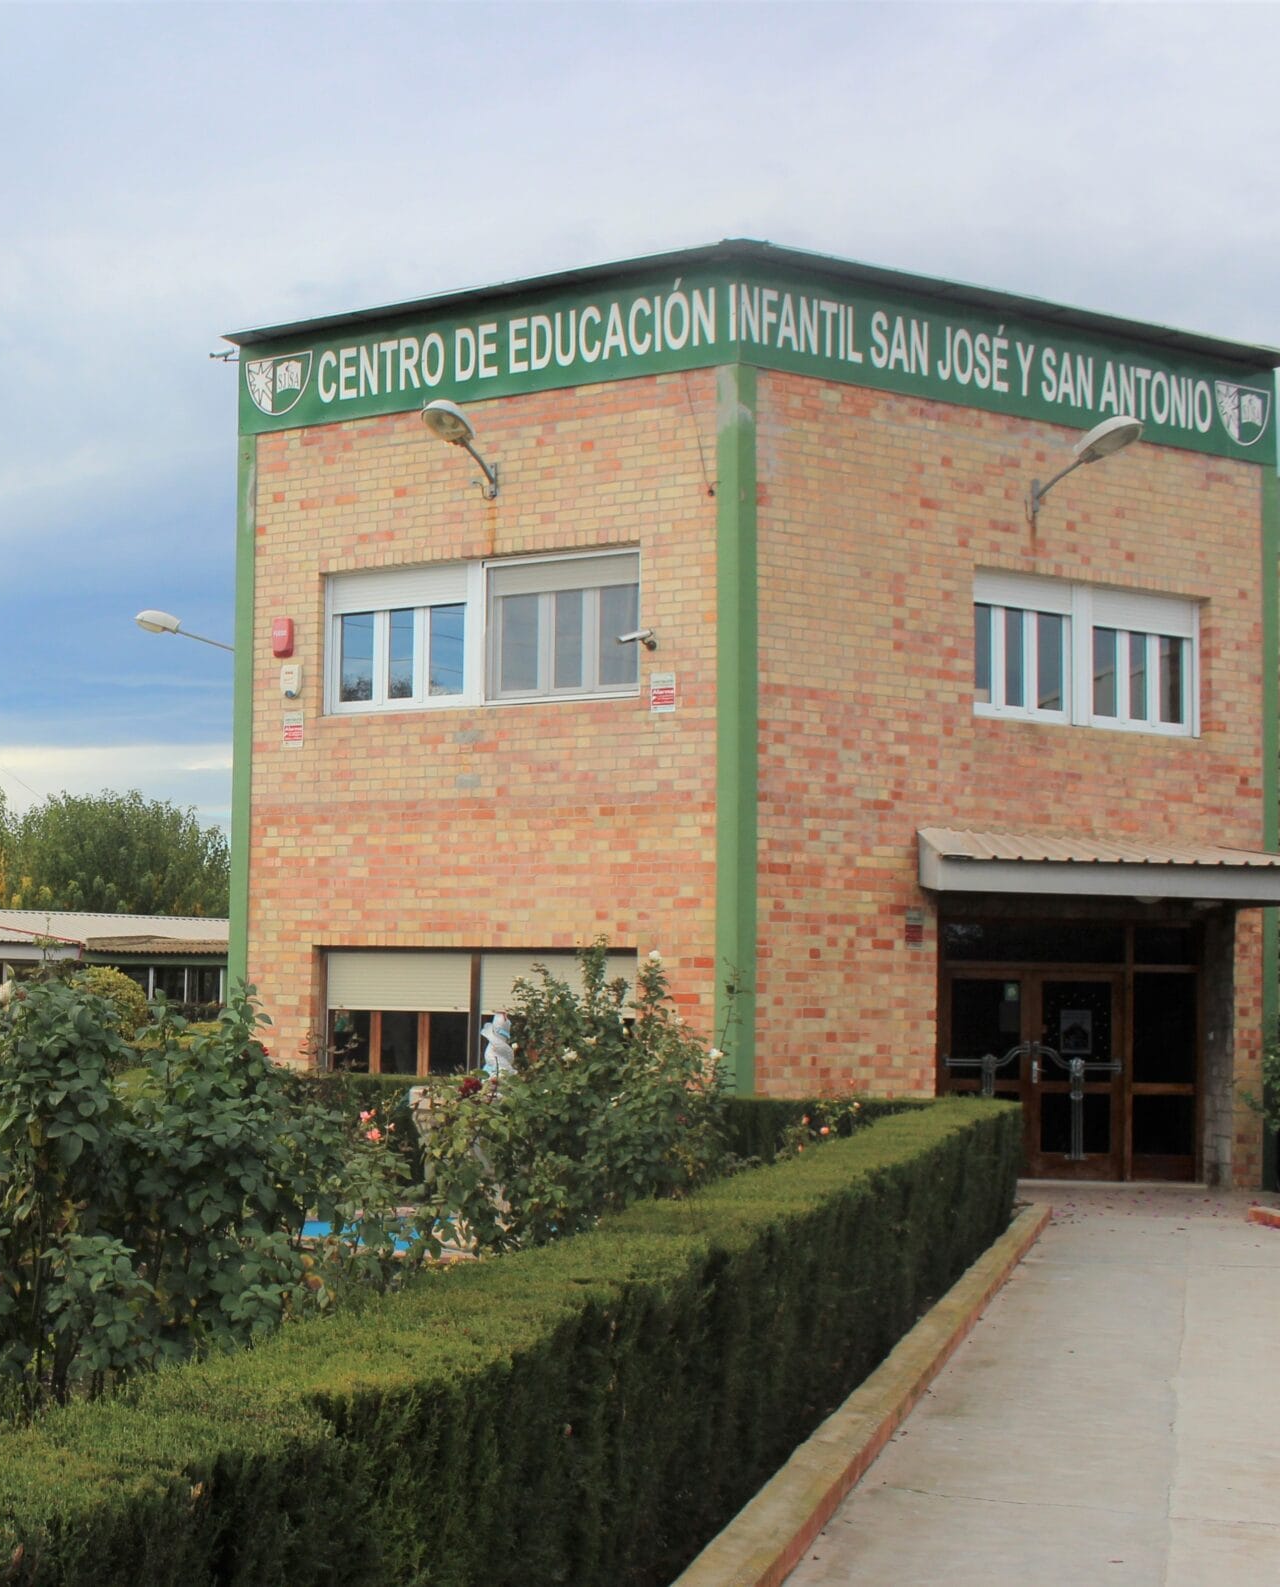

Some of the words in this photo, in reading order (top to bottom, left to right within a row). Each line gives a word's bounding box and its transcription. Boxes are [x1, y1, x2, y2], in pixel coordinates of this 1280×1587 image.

[318, 333, 445, 403] CENTRO
[455, 322, 498, 382] DE
[509, 277, 715, 374] EDUCACIÓN
[729, 283, 863, 363] INFANTIL
[870, 311, 928, 376] SAN
[937, 324, 1009, 392] JOSÉ
[1015, 341, 1035, 397] Y
[1041, 347, 1093, 410] SAN
[1099, 360, 1212, 433] ANTONIO
